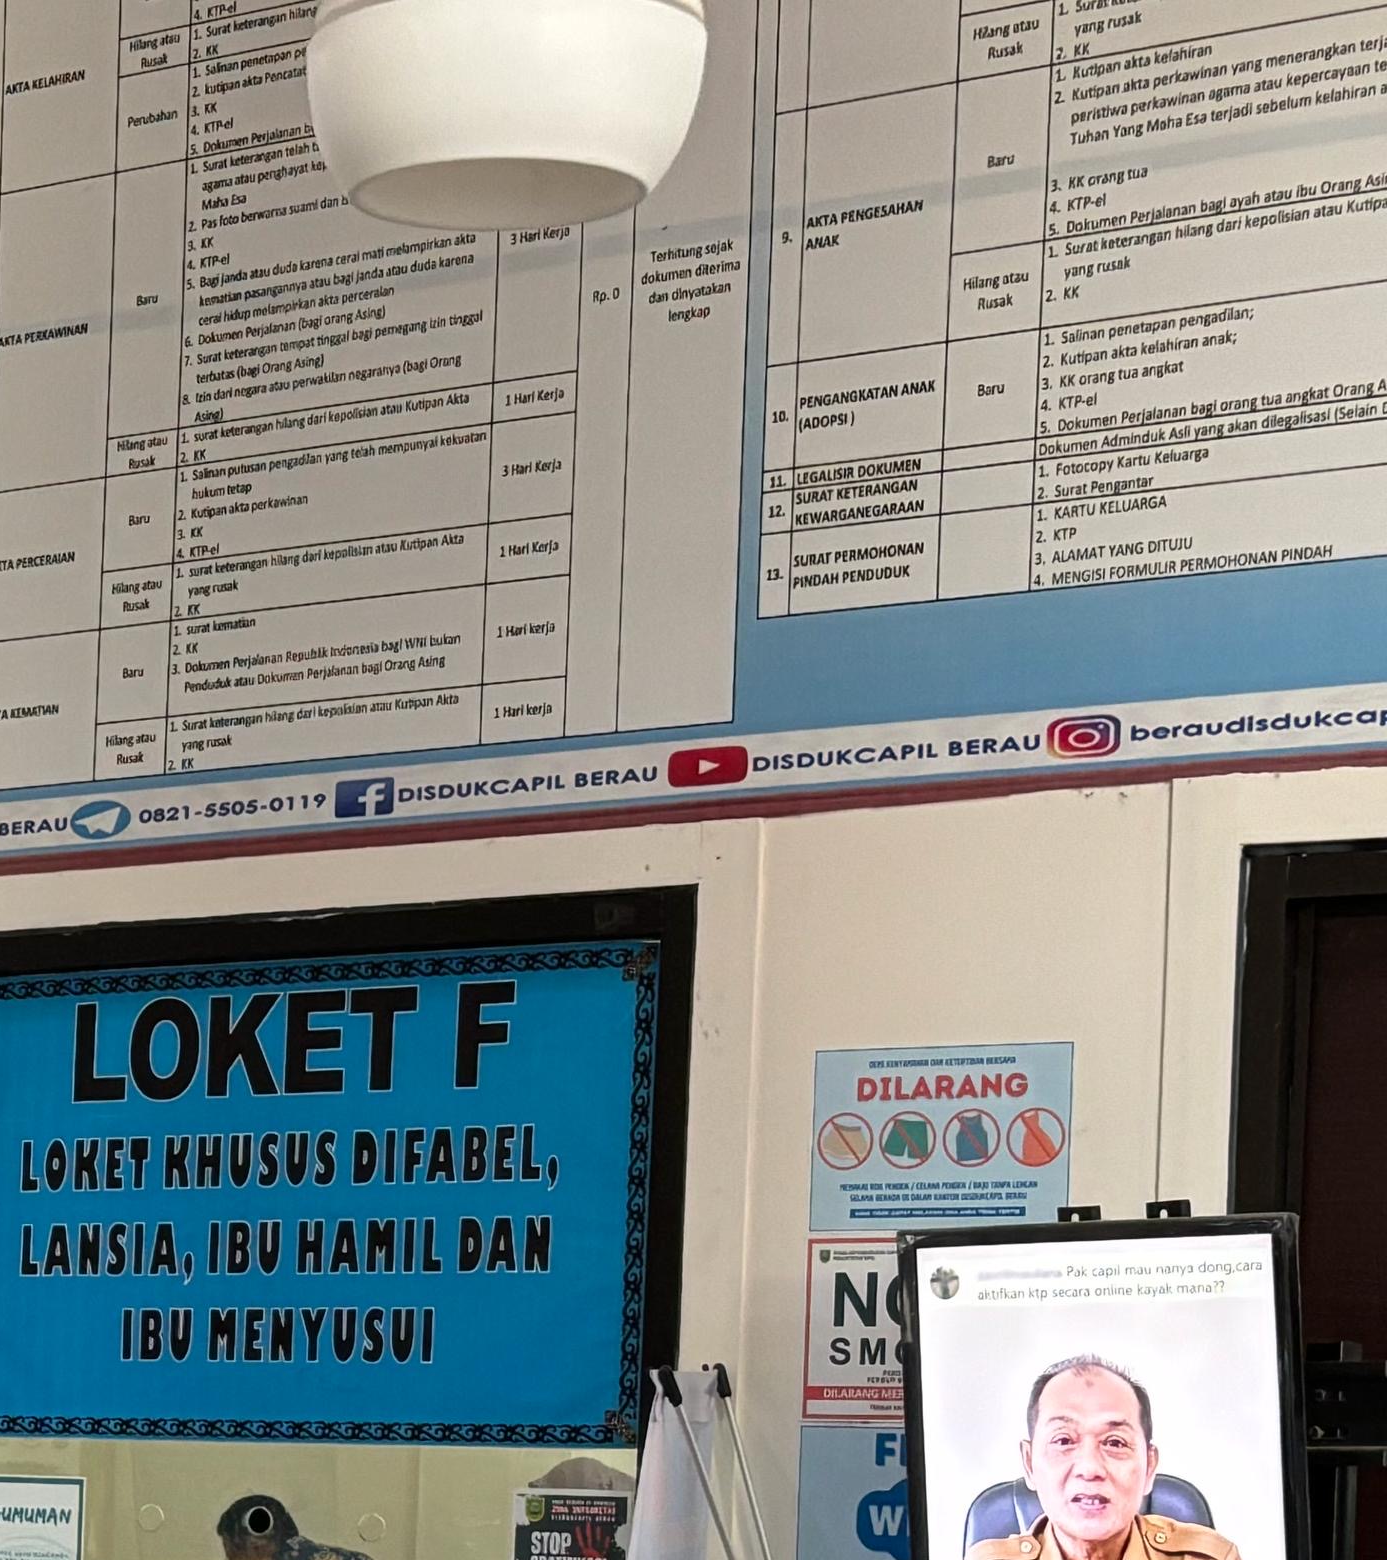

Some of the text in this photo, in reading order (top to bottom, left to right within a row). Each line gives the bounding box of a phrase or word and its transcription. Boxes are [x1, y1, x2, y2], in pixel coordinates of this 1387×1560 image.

[5, 70, 85, 96] AKTA KELAHIRAN
[807, 200, 924, 229] AKTA PENGESAHAN
[651, 239, 734, 263] Terhitung sejak
[805, 235, 839, 250] ANAK
[641, 259, 740, 286] dokumen diterima
[648, 282, 731, 303] dan dinyatakan
[668, 305, 710, 324] lengkap
[24, 323, 88, 345] PERKAWINAN
[797, 458, 921, 486] LEGALISIR DOKUMEN
[1056, 447, 1209, 477] Fotocopy Kartu Keluarga
[795, 479, 918, 505] SURAT KETERANGAN
[1054, 476, 1154, 498] Surat Pengantar
[795, 499, 924, 526] KEWARGANEGARAAN
[1054, 495, 1167, 520] KARTU KELUARGA
[1053, 527, 1076, 542] KTP
[16, 551, 75, 570] PERCERAIAN
[793, 542, 924, 568] SURAT PERMOHONAN
[1052, 536, 1193, 564] ALAMAT YANG DITUJU
[793, 565, 910, 589] PINDAH PENDUDUK
[1051, 544, 1333, 586] MENGISI FORMULIR PERMOHONAN PINDAH
[752, 732, 1041, 775] DISDUKCAPIL BERAU
[397, 764, 659, 804] DISDUKCAPIL BERAU
[139, 791, 327, 826] 0821-5505-0119
[71, 978, 518, 1105] LOKET F
[856, 1072, 1029, 1102] DILARANG
[19, 1122, 561, 1194] LOKET KHUSUS DIFABEL,
[19, 1213, 553, 1286] LANSIA, IBU HAMIL DAN
[1066, 1264, 1088, 1278] Pak
[1092, 1262, 1122, 1280] capil
[1125, 1264, 1151, 1276] mau
[1155, 1264, 1194, 1279] nanya
[977, 1280, 1226, 1302] aktifkan ktp secara online kayak mana??
[120, 1305, 435, 1365] IBU MENYUSUI
[823, 1387, 879, 1400] DILARANG
[530, 1531, 572, 1555] STOP
